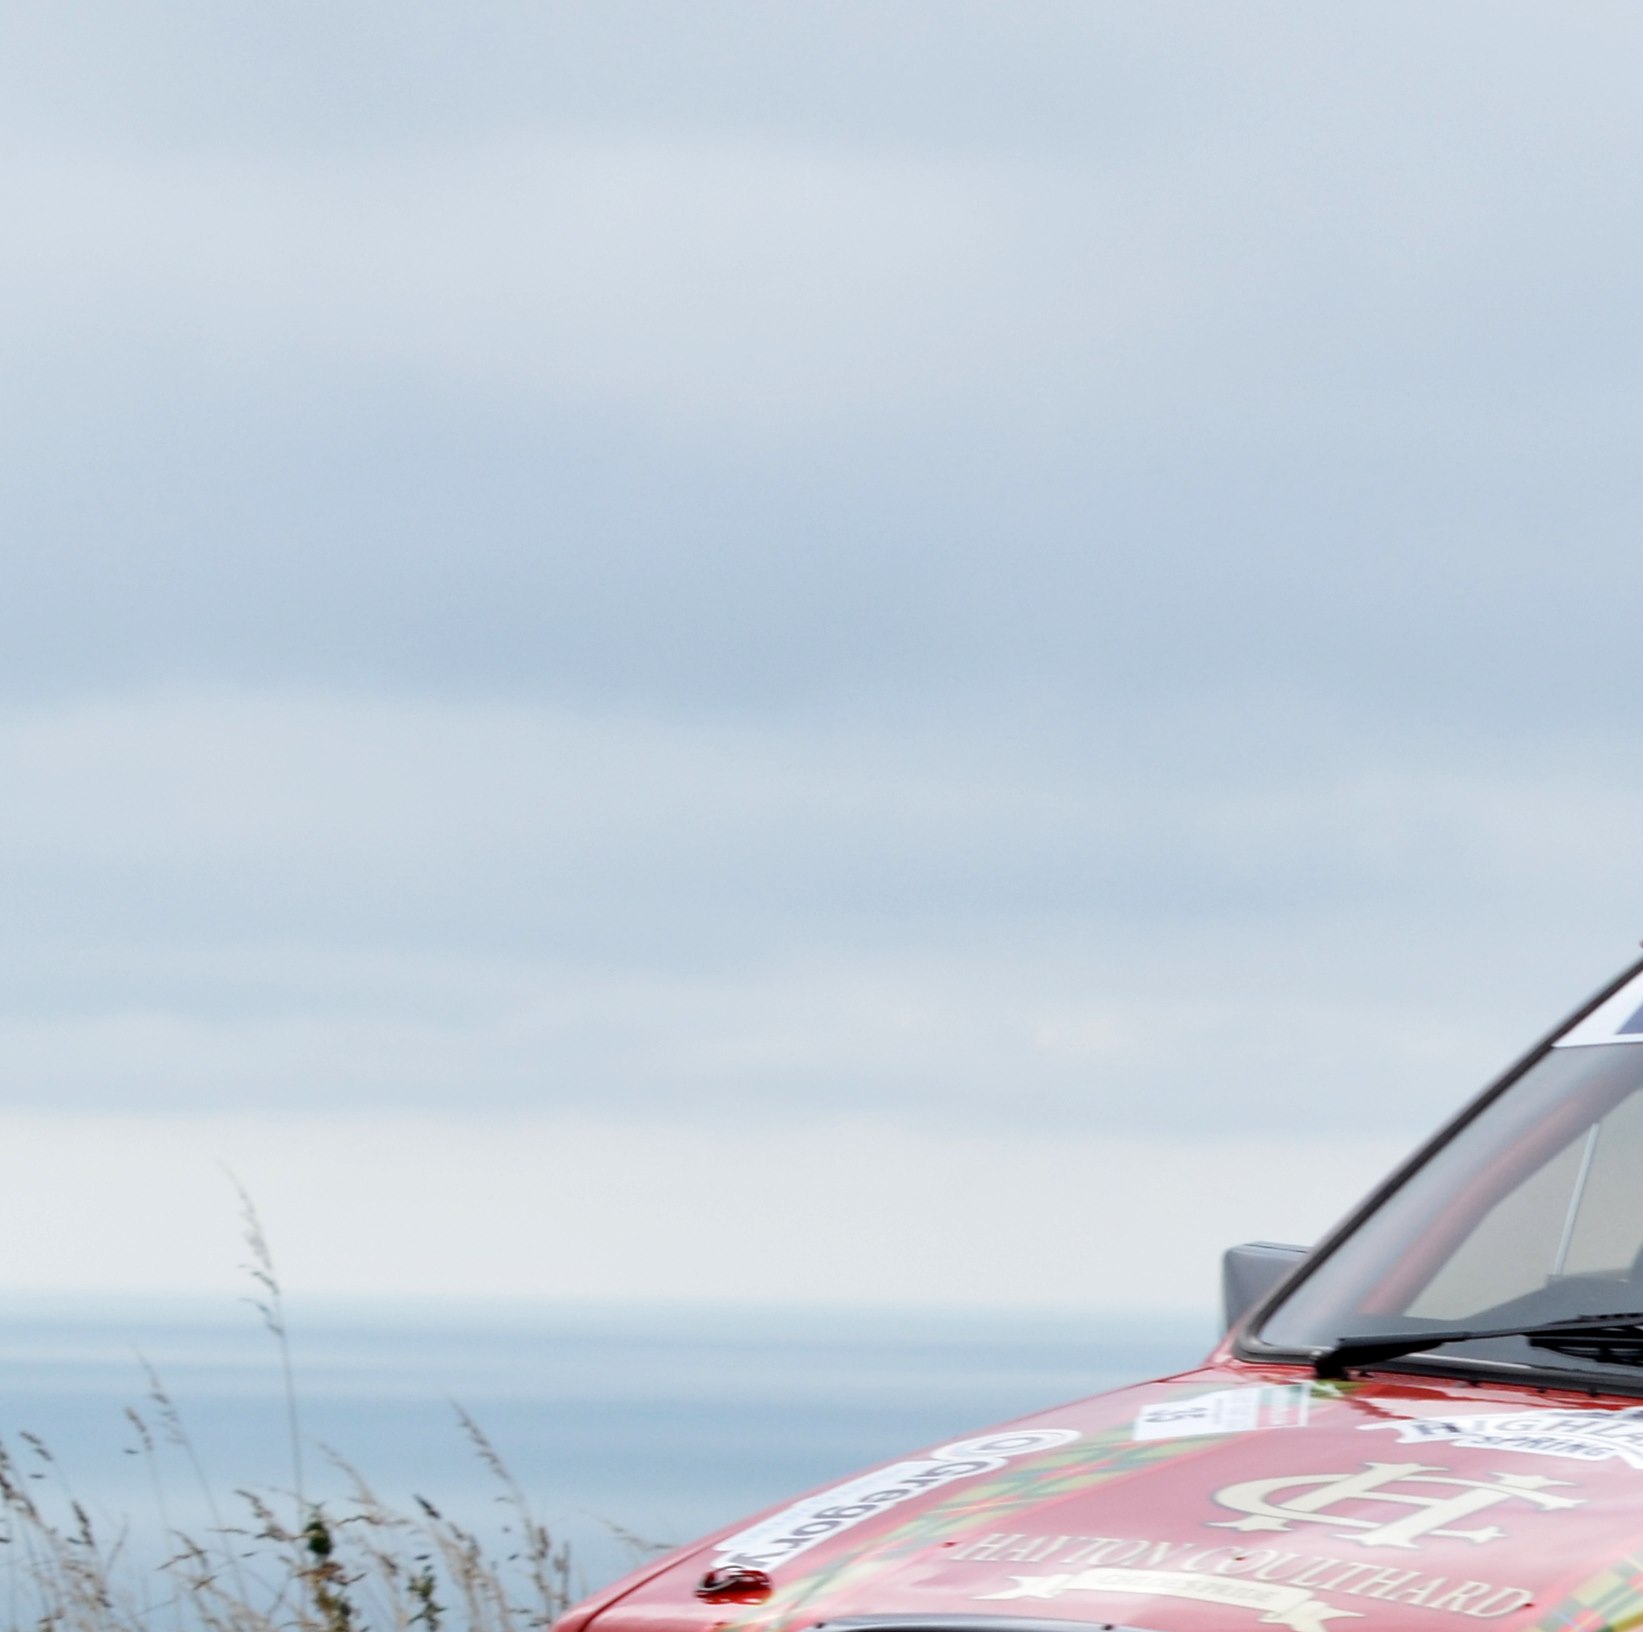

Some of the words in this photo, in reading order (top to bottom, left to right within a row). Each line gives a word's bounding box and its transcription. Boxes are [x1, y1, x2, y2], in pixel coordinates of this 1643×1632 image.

[1471, 1435, 1616, 1458] SPRING
[950, 1532, 1184, 1569] HAYTON
[1177, 1540, 1535, 1619] COULTHARD
